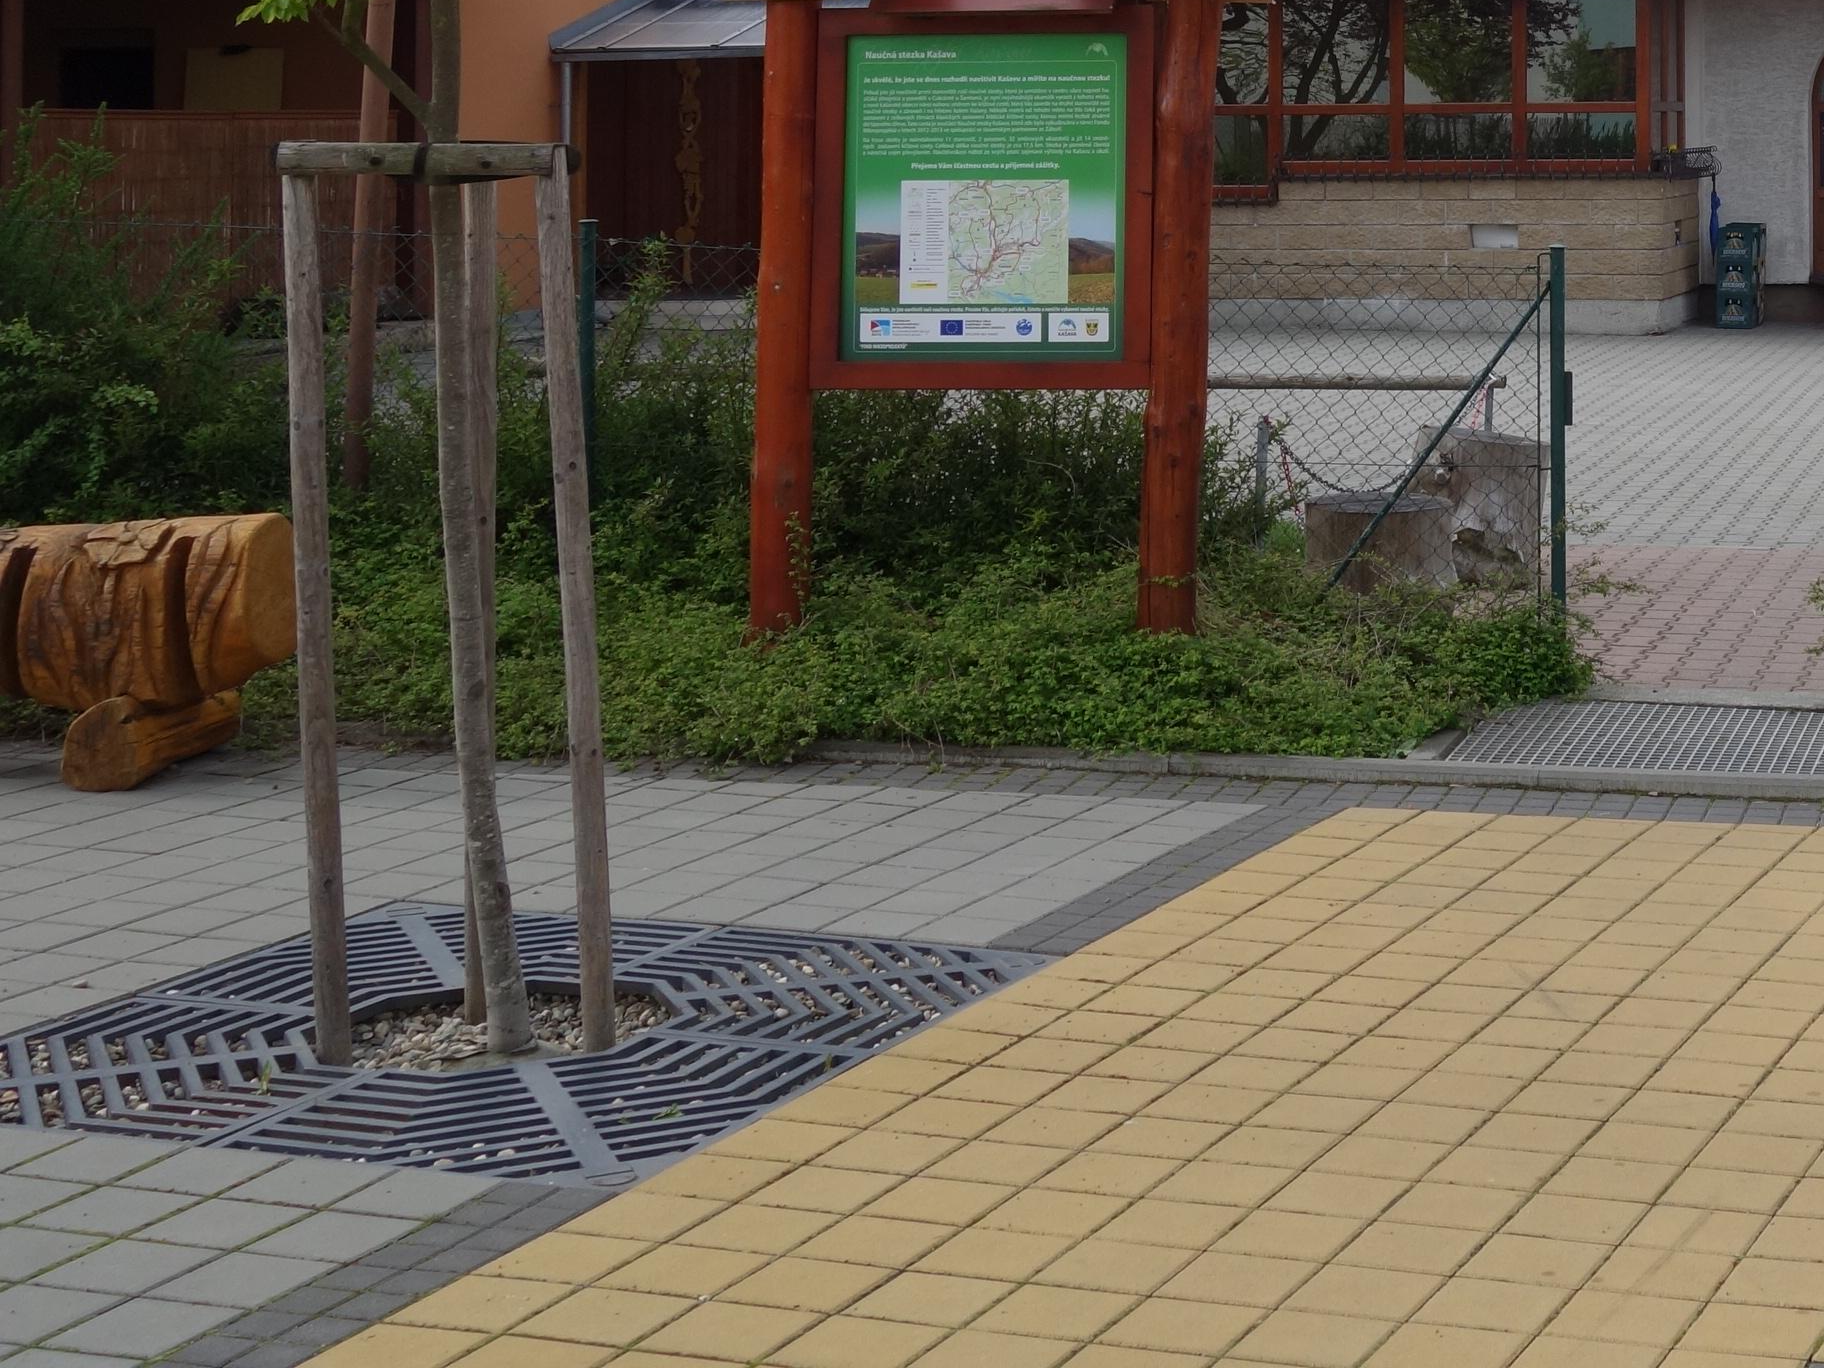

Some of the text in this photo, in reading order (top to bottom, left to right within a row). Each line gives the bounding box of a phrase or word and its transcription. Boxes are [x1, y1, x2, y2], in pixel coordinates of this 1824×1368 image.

[865, 50, 957, 59] Naučná stezka Kašava
